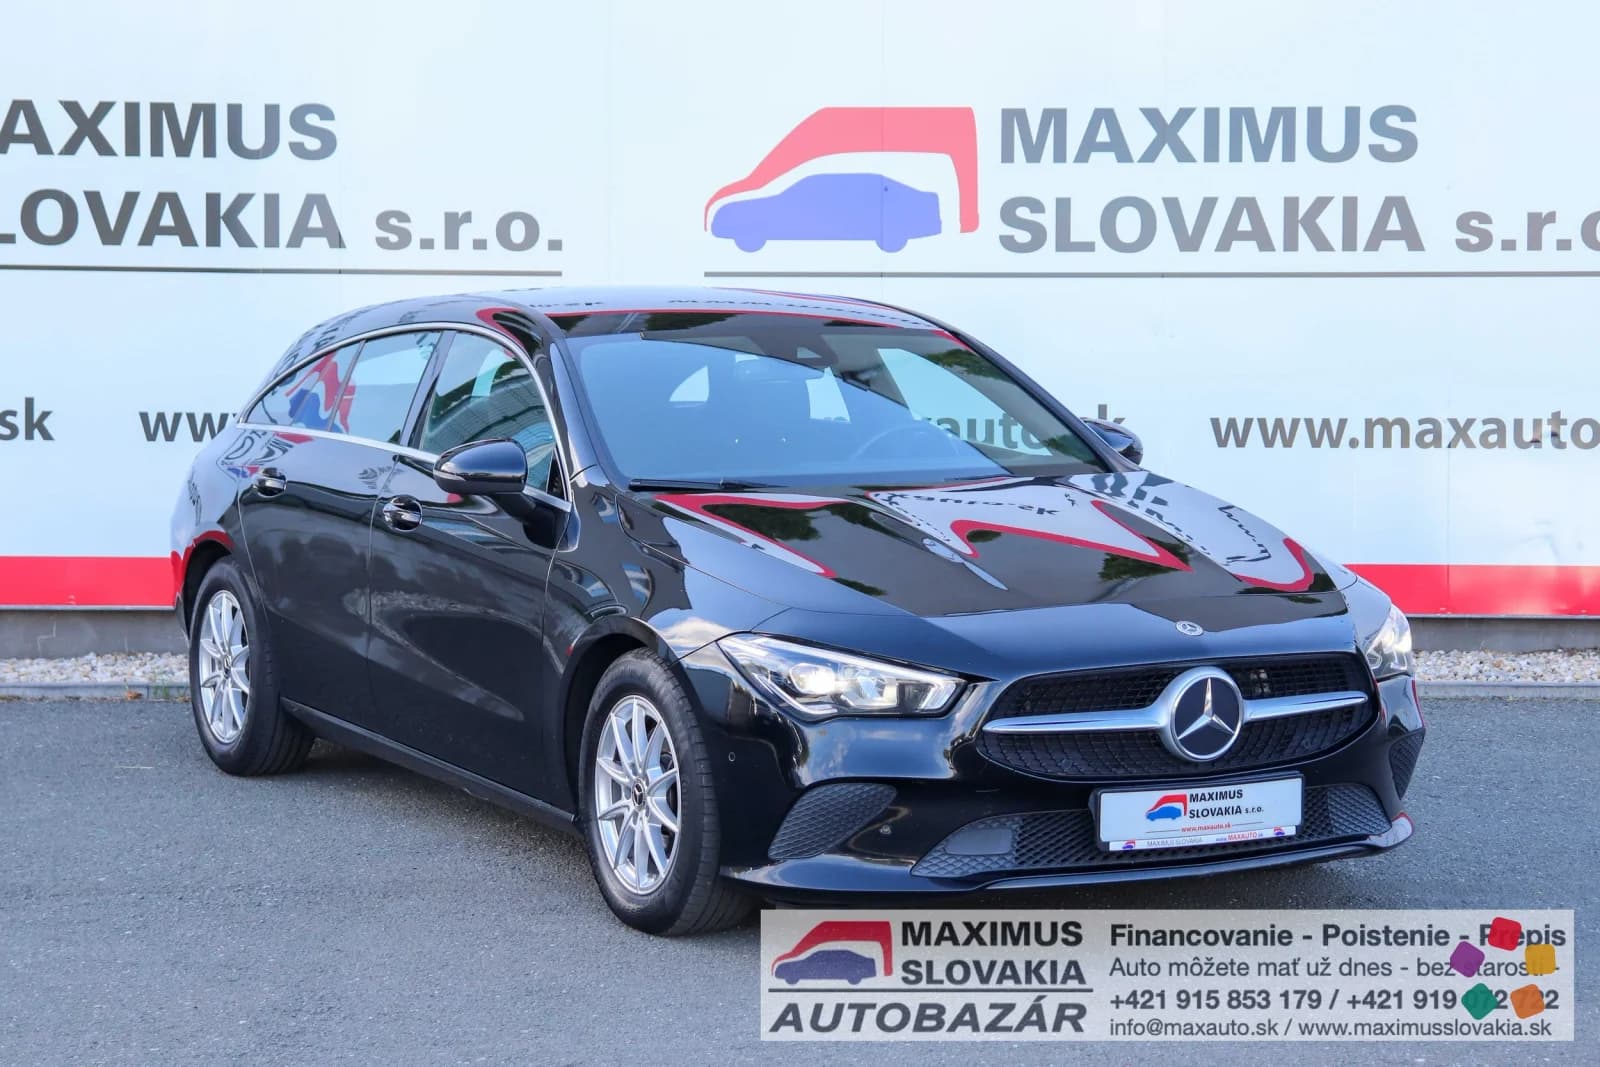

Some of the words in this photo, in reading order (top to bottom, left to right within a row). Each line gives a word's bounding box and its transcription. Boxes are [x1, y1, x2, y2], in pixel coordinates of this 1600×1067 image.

[0, 99, 338, 161] AXIMUS
[1001, 105, 1419, 163] MAXIMUS
[375, 209, 564, 252] s.r.o.
[999, 196, 1426, 253] SLOVAKIA
[1189, 789, 1243, 803] MAXIMUS
[1189, 805, 1242, 819] SLOVAKIA
[1244, 806, 1265, 814] s.r.o.
